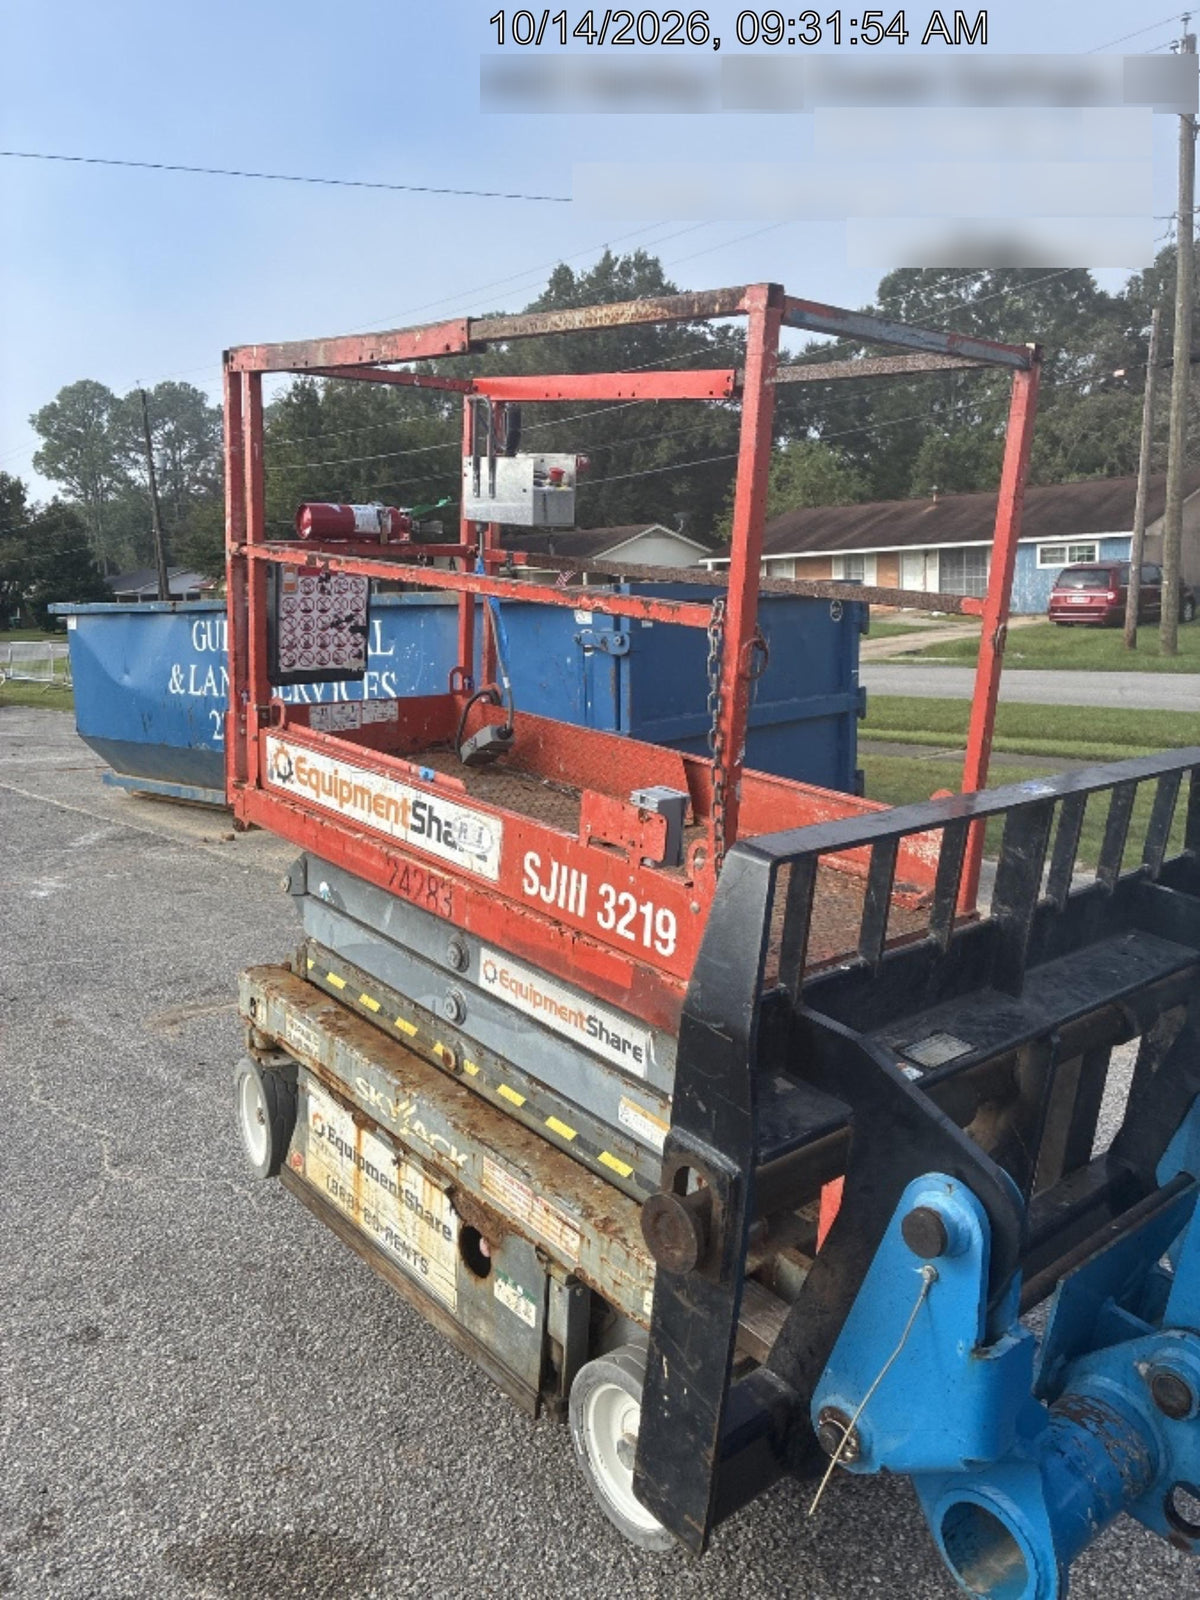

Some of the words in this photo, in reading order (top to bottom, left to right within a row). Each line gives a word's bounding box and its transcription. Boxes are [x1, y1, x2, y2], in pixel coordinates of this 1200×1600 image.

[294, 754, 488, 864] EquipmentSha
[521, 850, 587, 919] SJIII
[595, 882, 678, 959] 3219
[498, 966, 644, 1065] EquipmentShare
